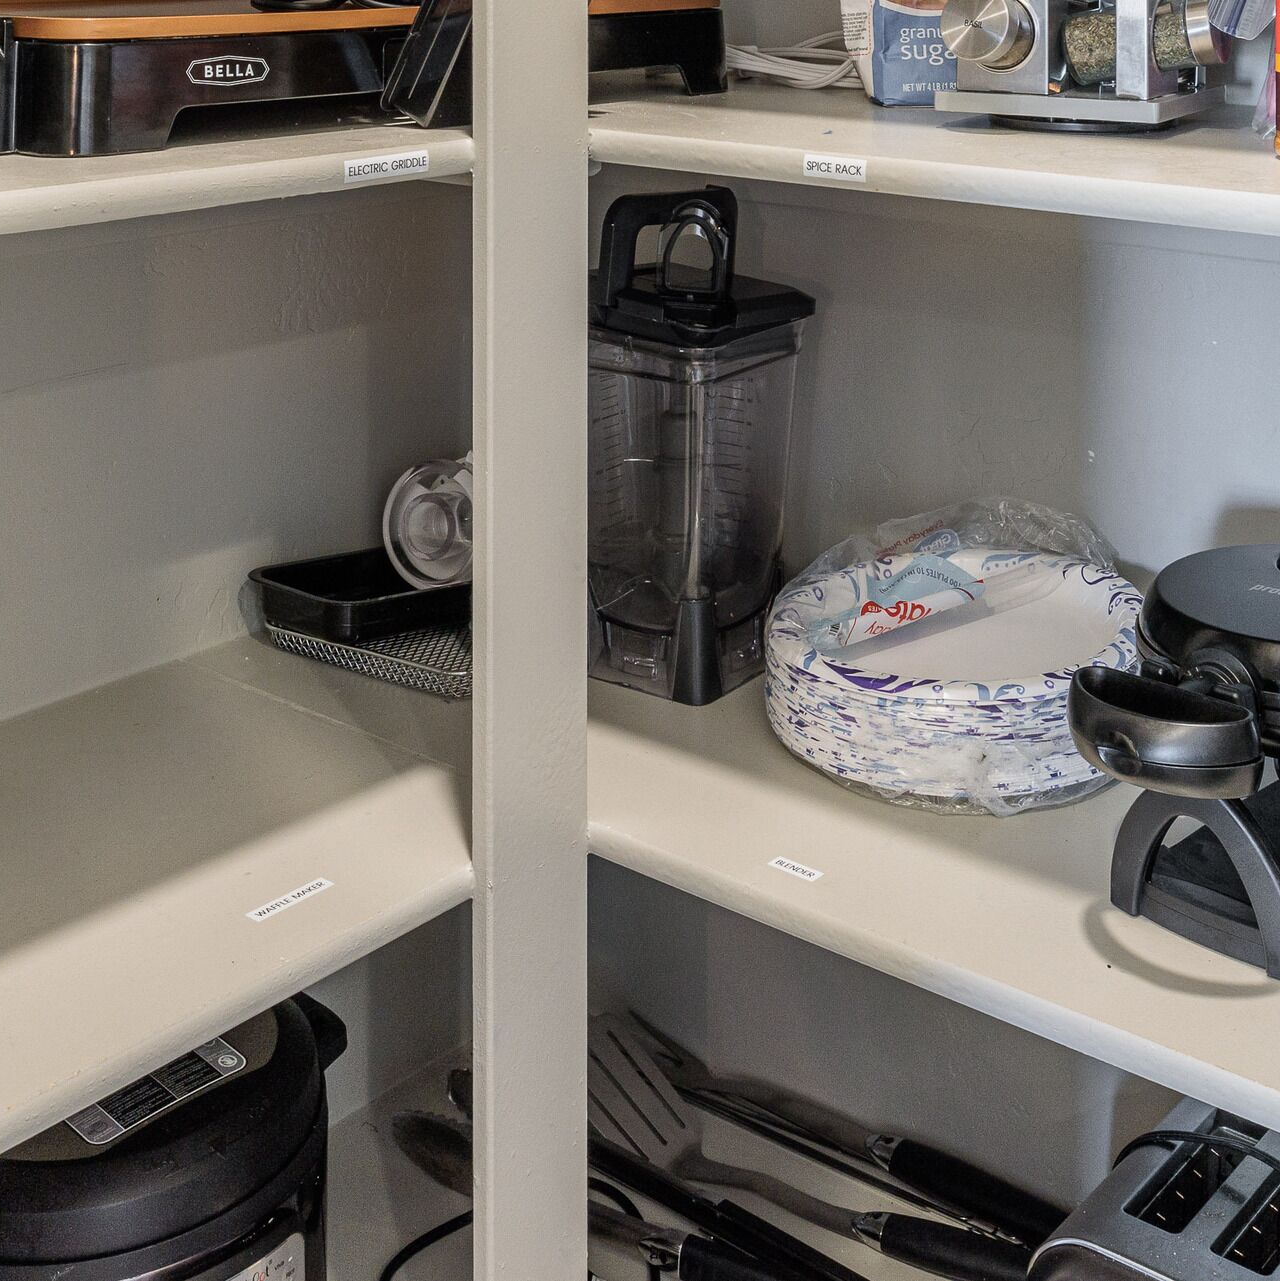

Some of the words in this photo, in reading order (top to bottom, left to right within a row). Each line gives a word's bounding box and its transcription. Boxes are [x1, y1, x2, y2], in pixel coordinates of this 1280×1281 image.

[964, 19, 983, 30] BASIL
[204, 64, 254, 78] BELLA
[348, 161, 388, 177] ELECTRIC
[391, 156, 427, 170] GRIDDLE
[806, 160, 832, 173] SPICE
[835, 163, 862, 176] RACK
[925, 568, 949, 583] PLATES
[254, 897, 292, 917] WAFFLE
[291, 881, 326, 899] MAKER
